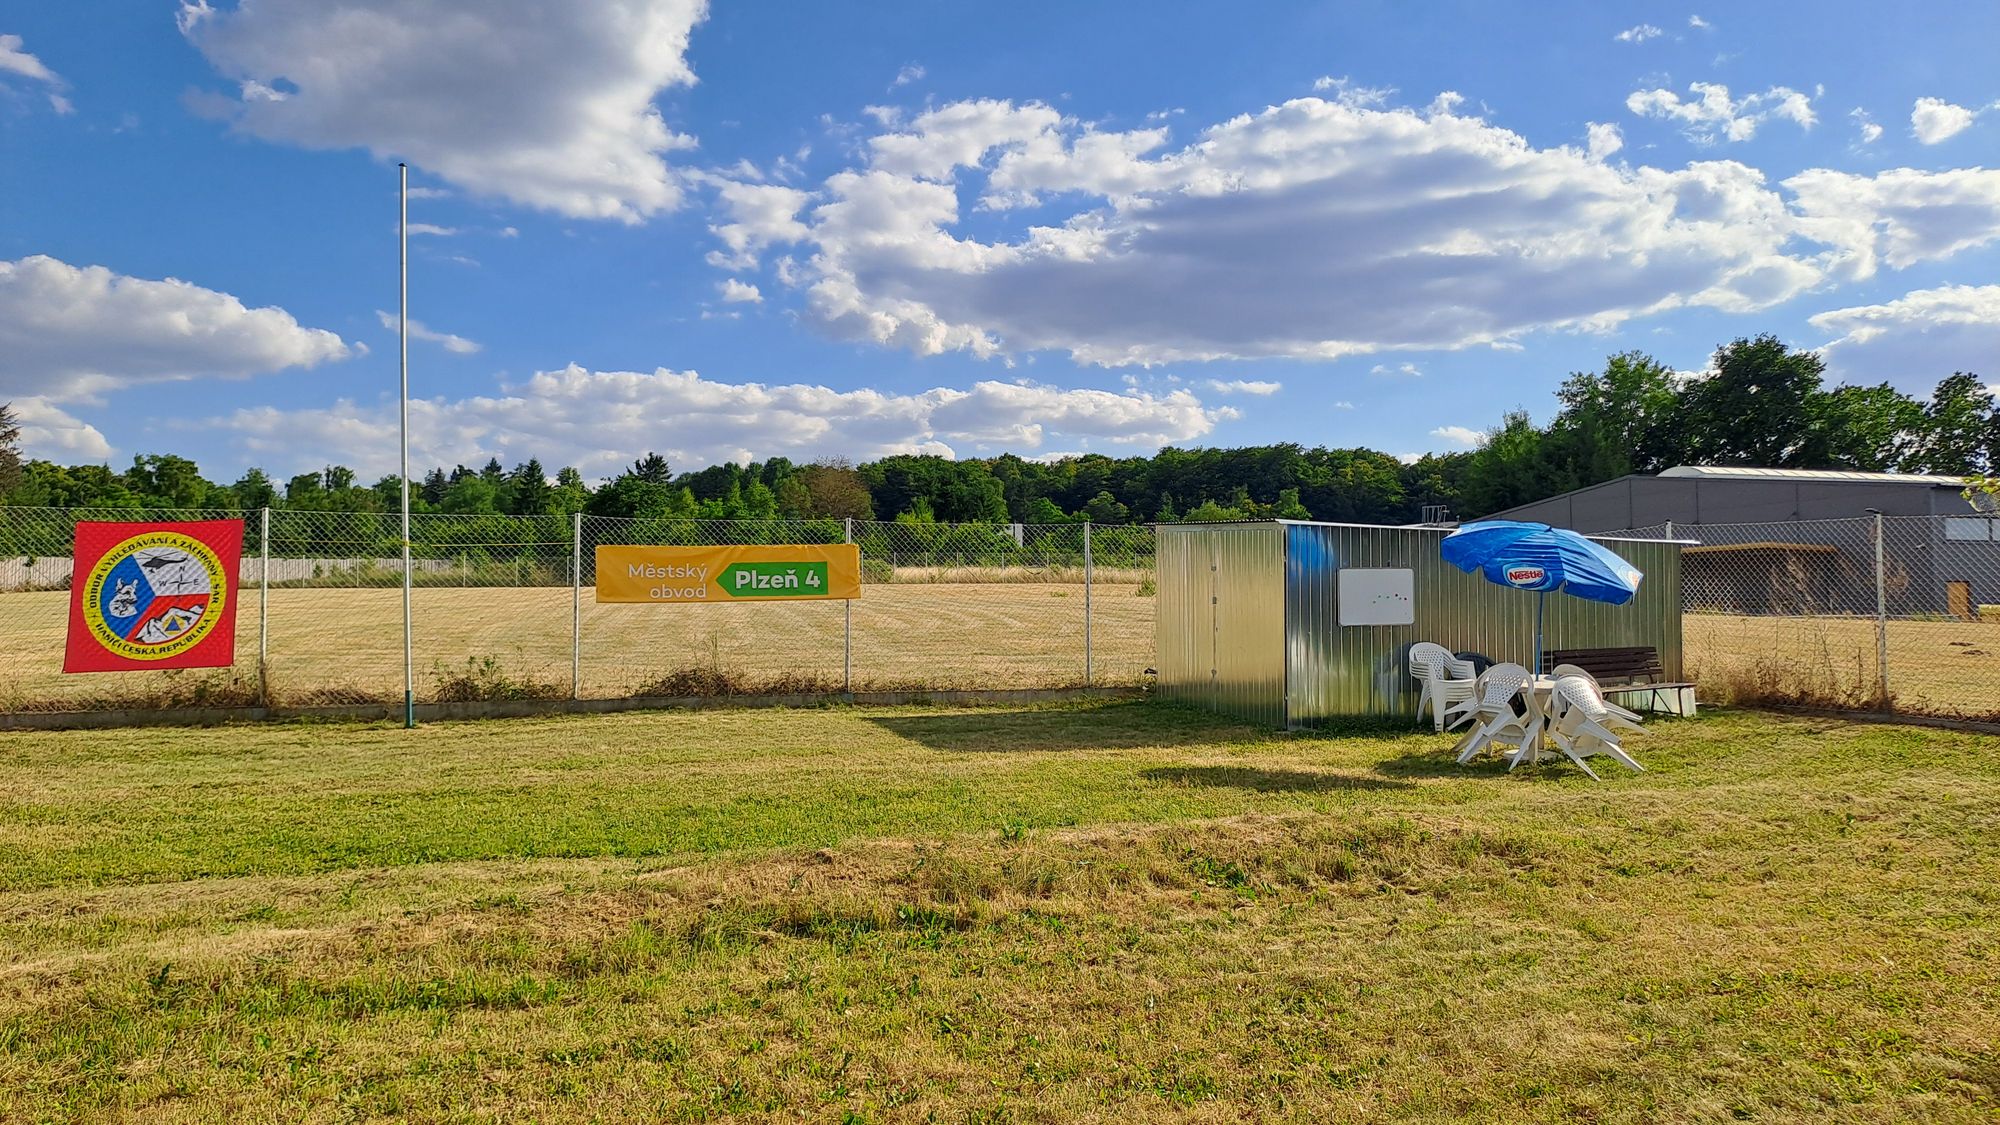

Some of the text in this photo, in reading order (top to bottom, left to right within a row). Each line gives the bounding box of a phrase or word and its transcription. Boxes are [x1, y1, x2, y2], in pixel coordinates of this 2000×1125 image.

[627, 562, 708, 582] Městský
[735, 569, 821, 590] Plzeň 4
[649, 583, 708, 599] obvod
